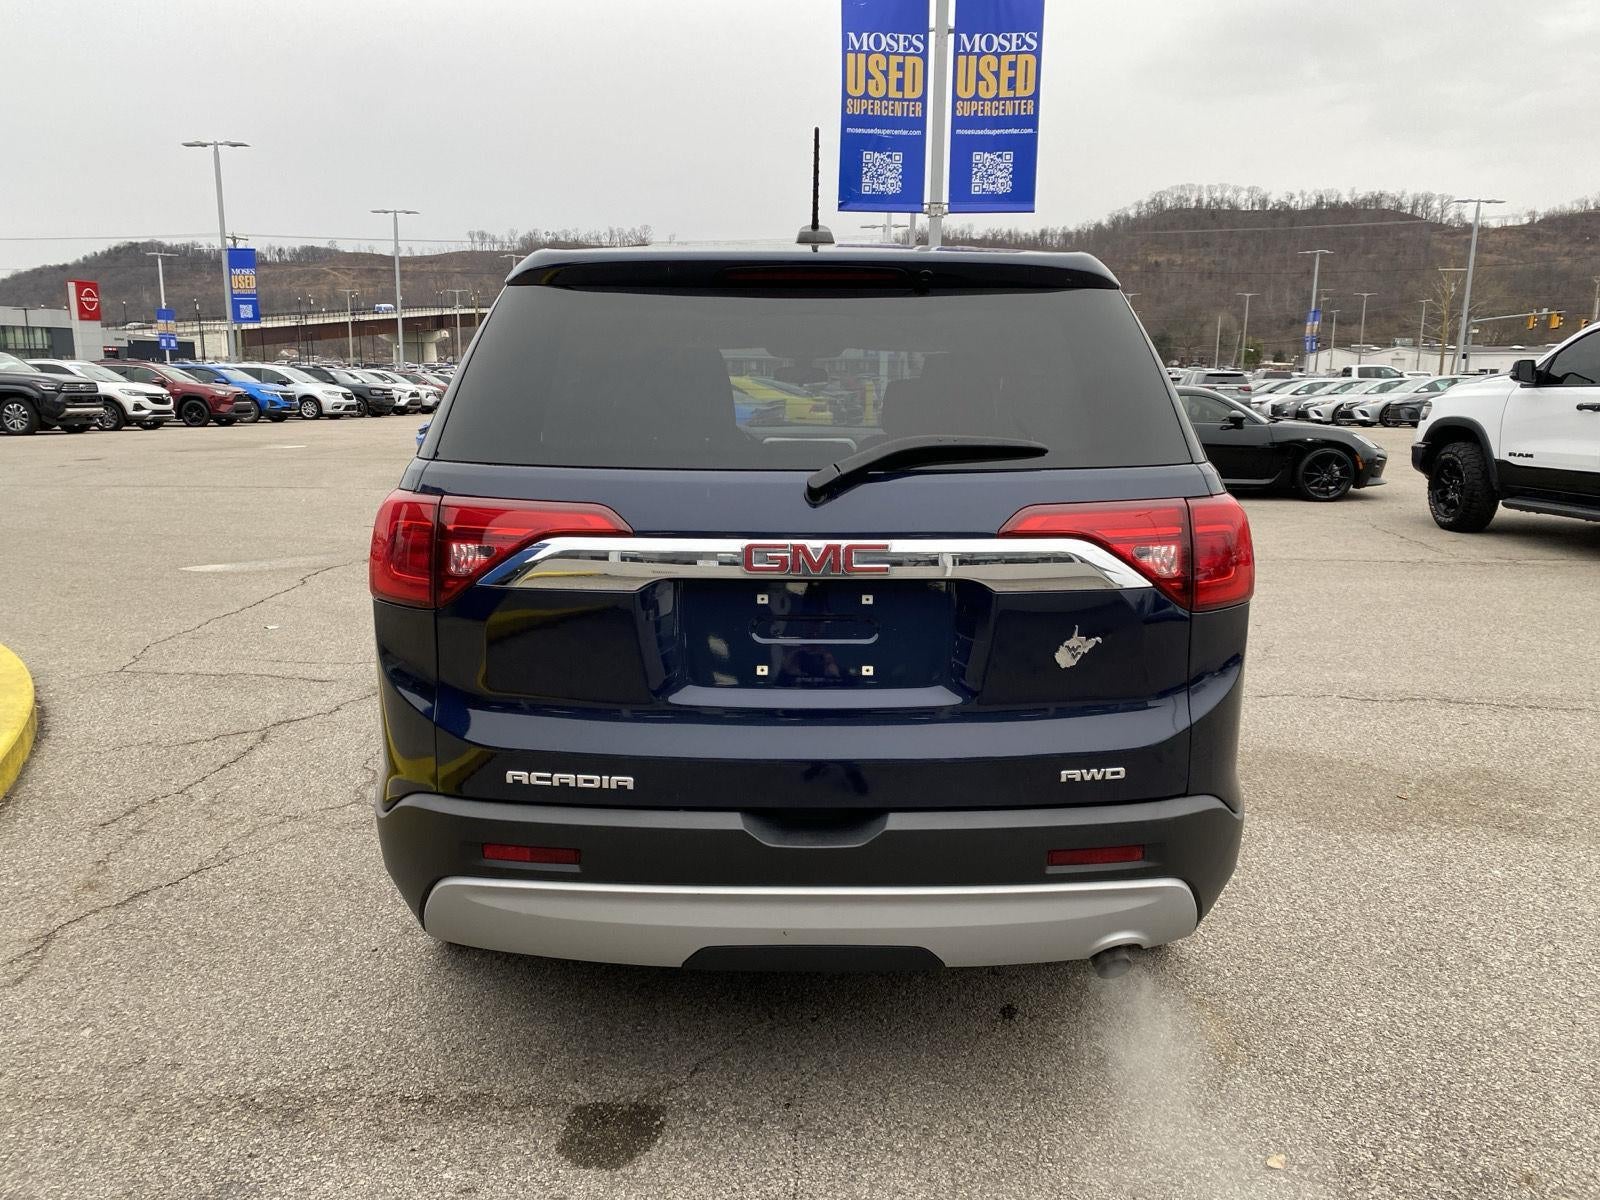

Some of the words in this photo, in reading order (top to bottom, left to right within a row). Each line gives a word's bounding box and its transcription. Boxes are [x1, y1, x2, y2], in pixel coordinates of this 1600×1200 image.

[847, 32, 924, 54] MOSES
[959, 31, 1038, 53] MOSES
[846, 53, 924, 99] USED
[956, 54, 1037, 99] USED
[846, 98, 922, 117] SUPERCENTER
[956, 99, 1034, 117] SUPERCENTER
[846, 127, 922, 136] mosesusedsupercenter.com
[231, 274, 257, 289] USED
[743, 543, 891, 575] GMC
[505, 770, 634, 790] ACADIA
[1060, 766, 1126, 783] AWD
